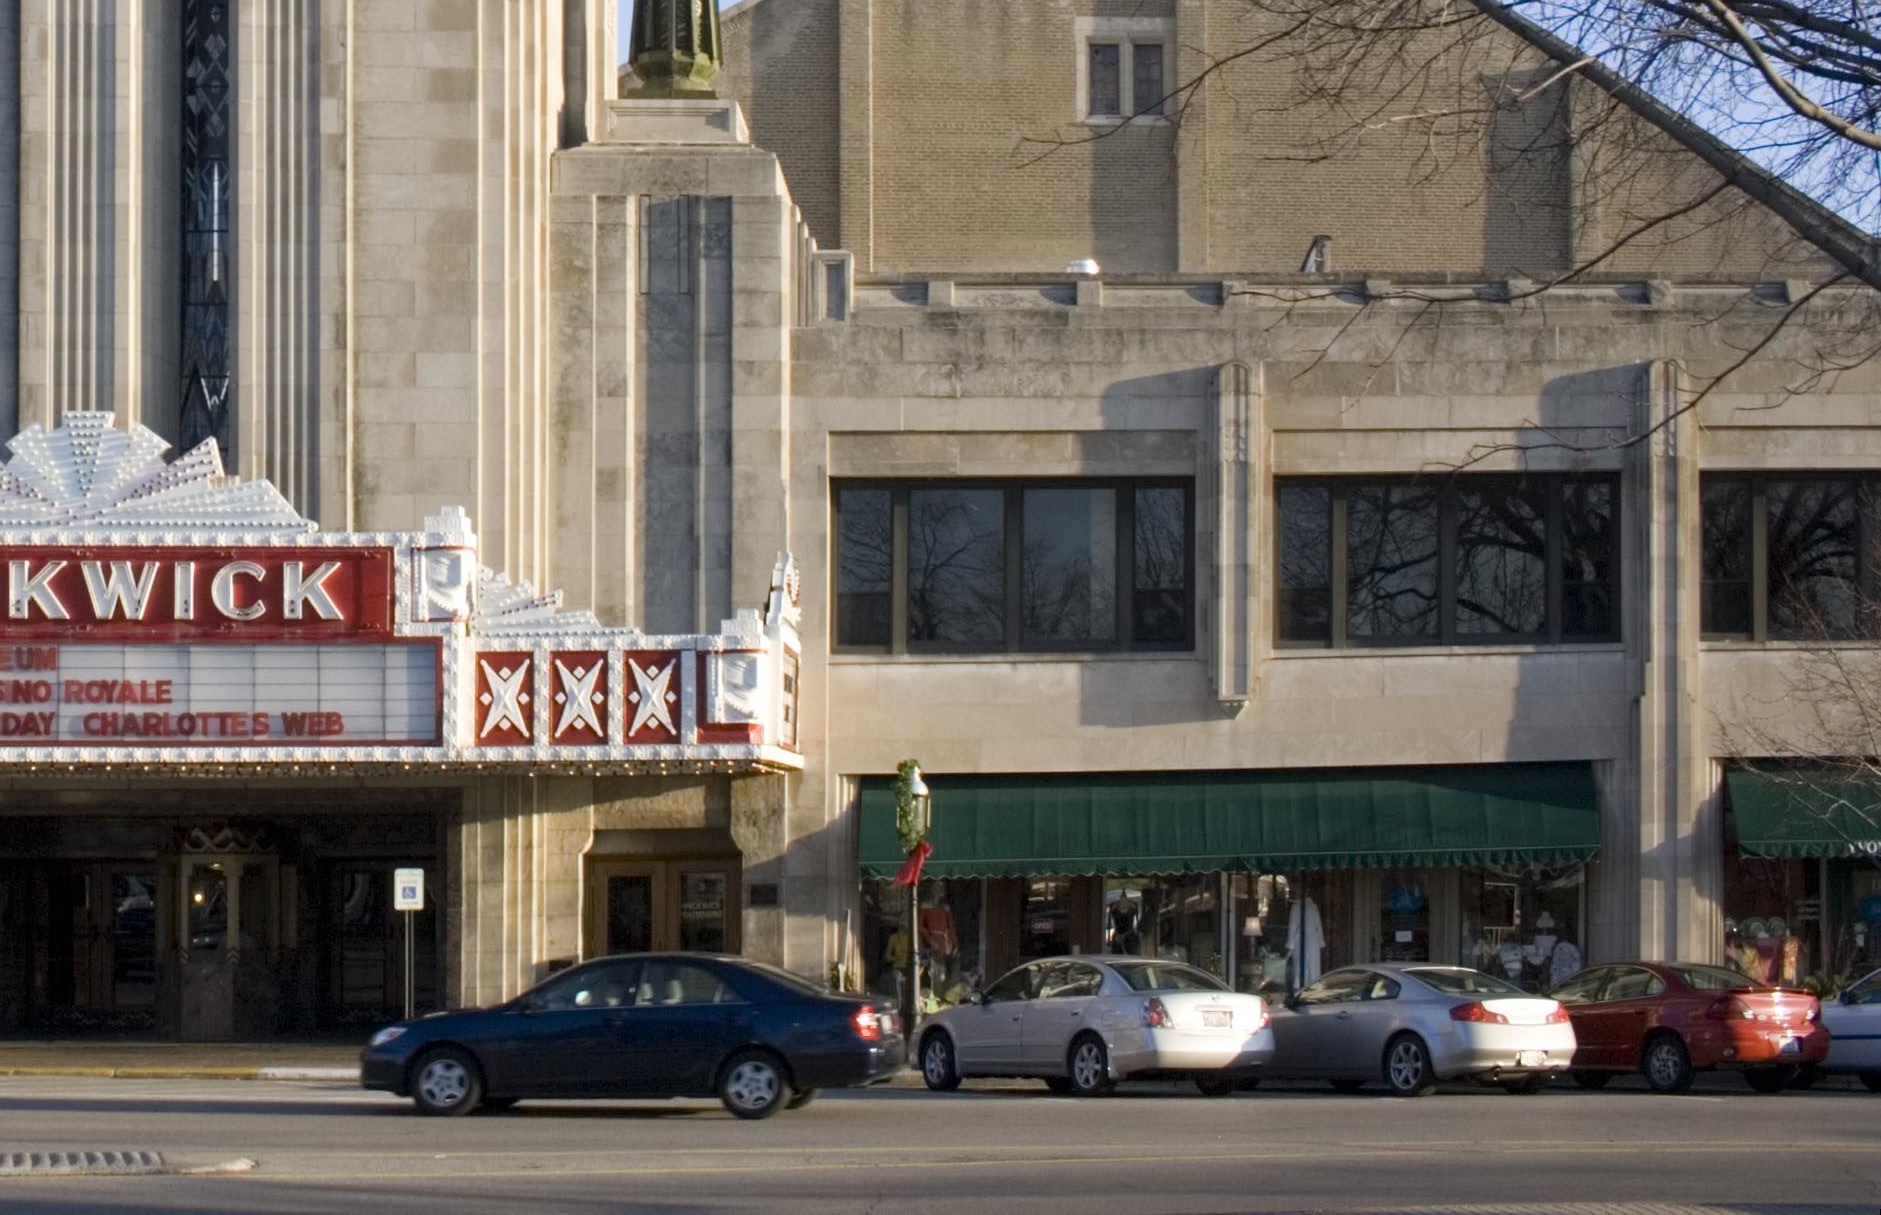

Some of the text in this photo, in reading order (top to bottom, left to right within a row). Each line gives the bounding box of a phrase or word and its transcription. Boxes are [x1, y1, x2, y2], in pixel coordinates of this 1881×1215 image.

[63, 679, 173, 703] ROYALE
[83, 712, 269, 736] CHARLOTTES
[281, 712, 344, 735] WEB
